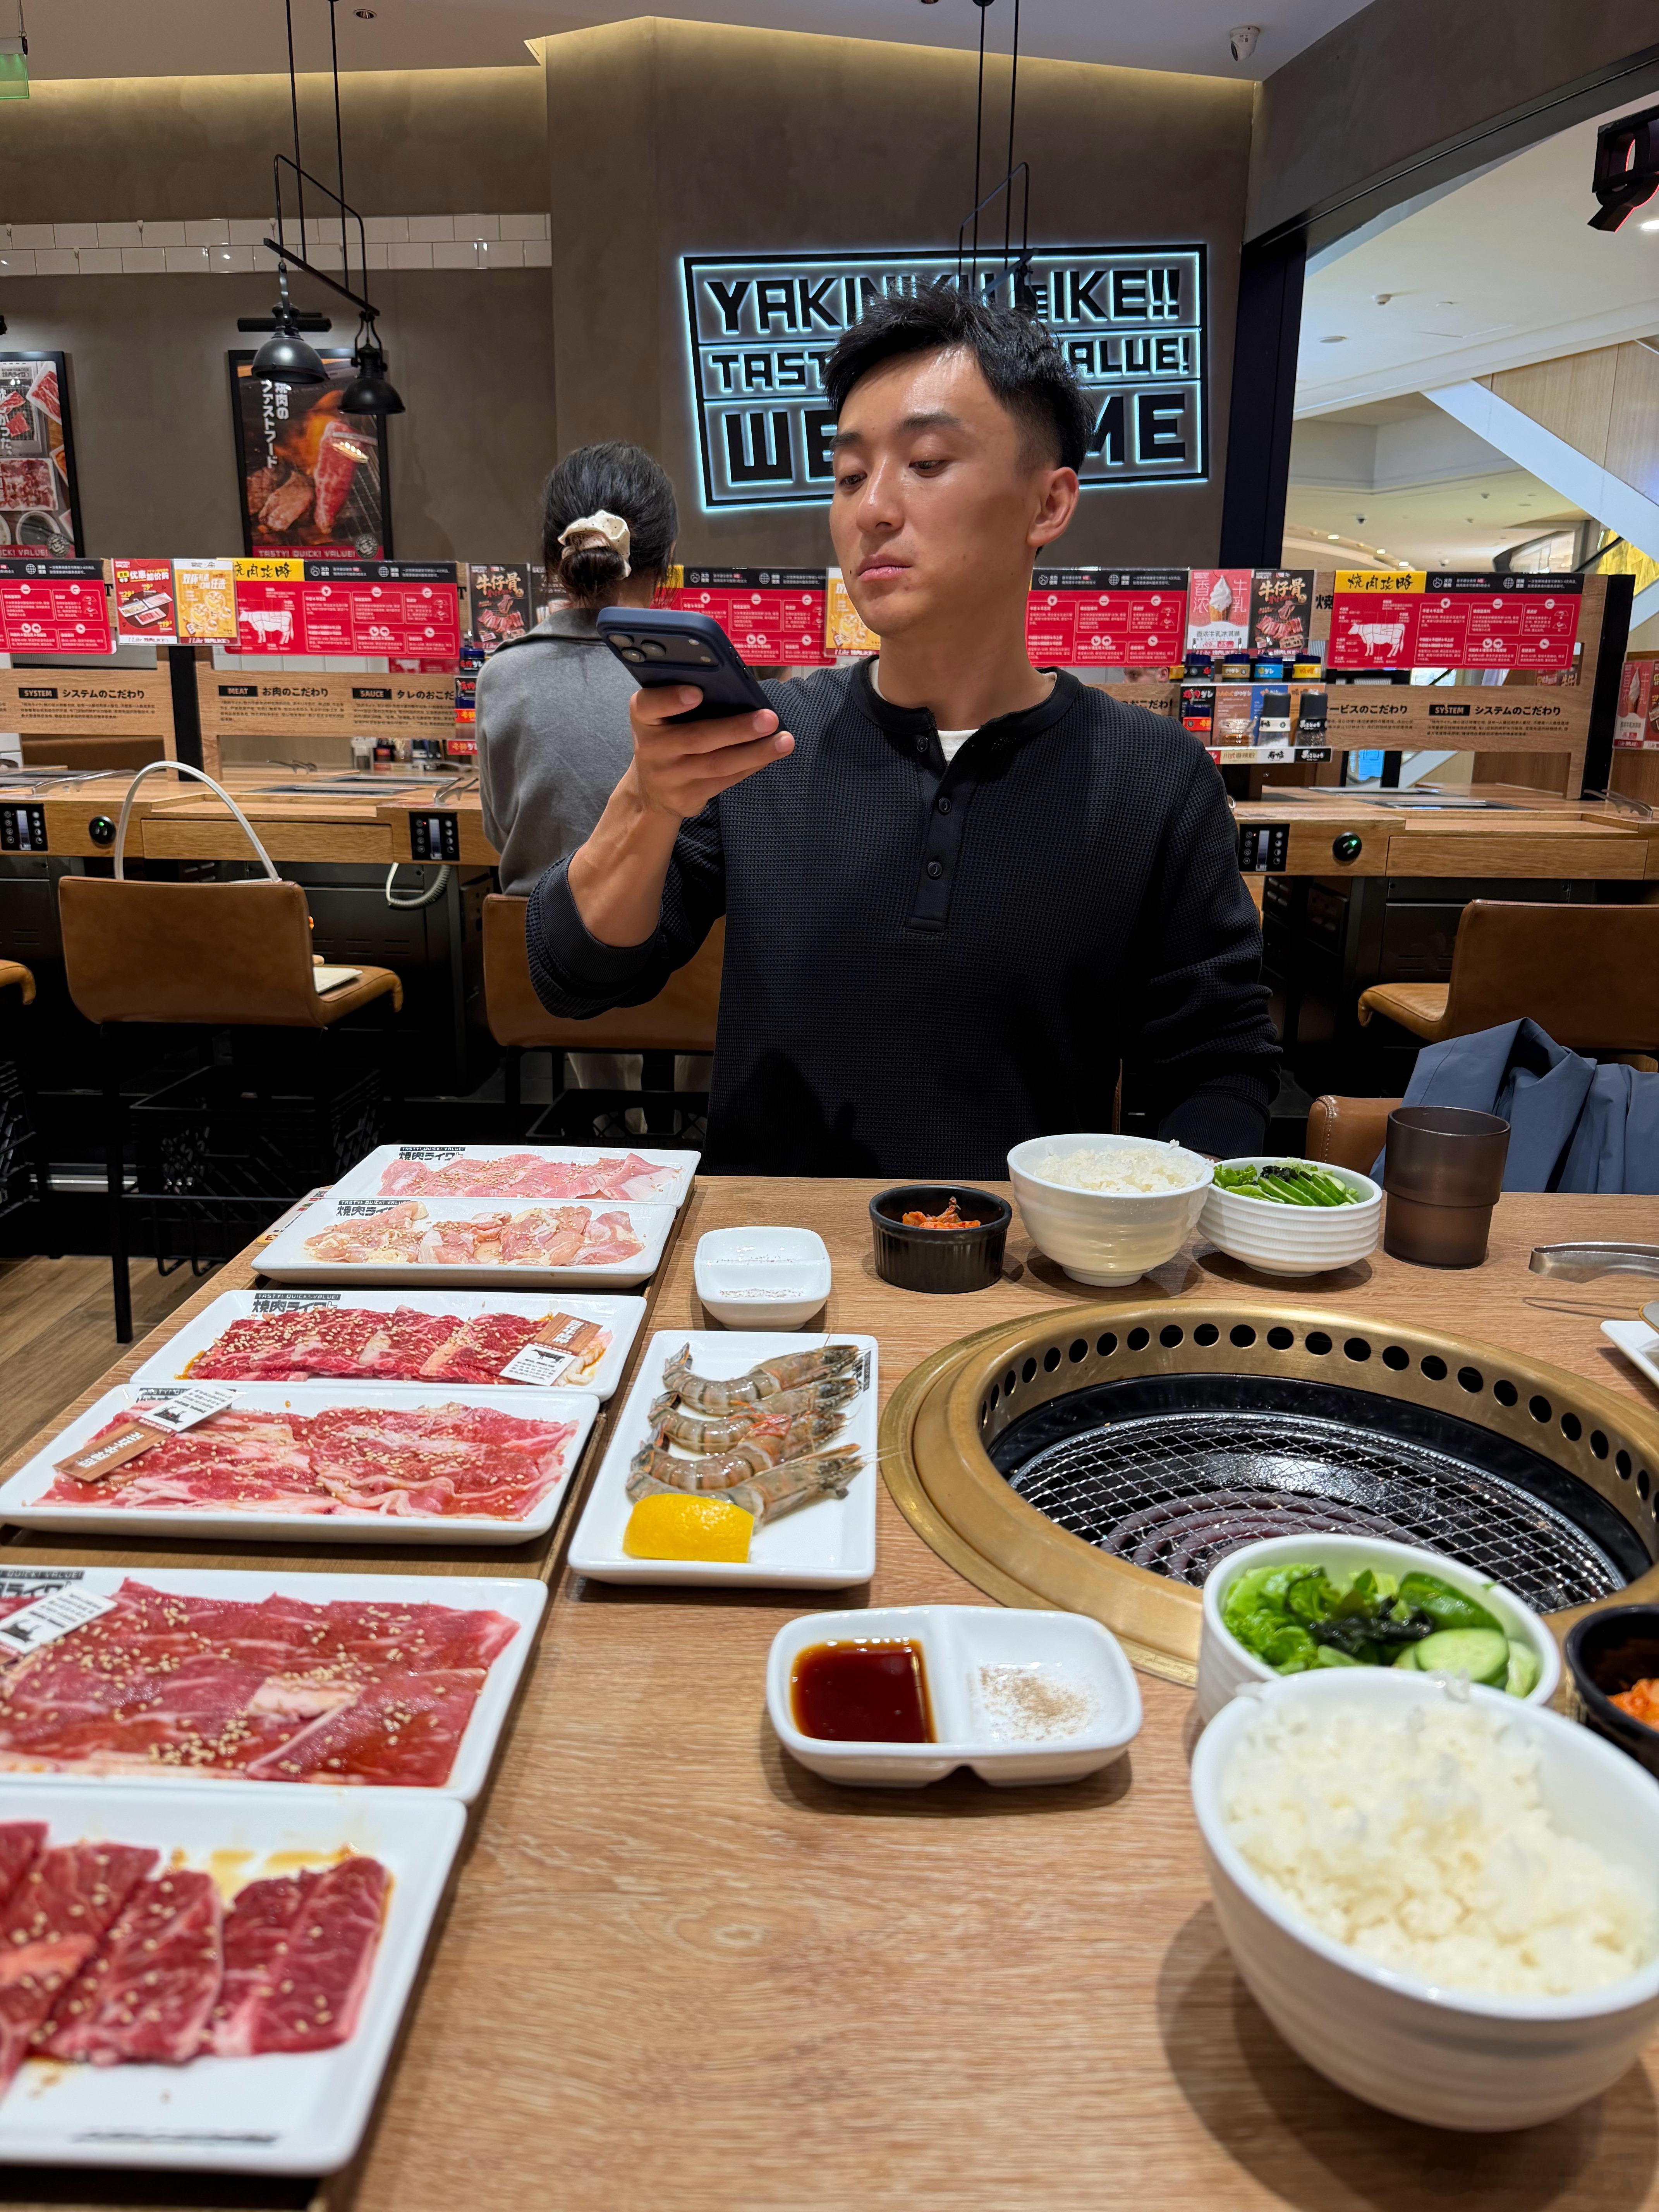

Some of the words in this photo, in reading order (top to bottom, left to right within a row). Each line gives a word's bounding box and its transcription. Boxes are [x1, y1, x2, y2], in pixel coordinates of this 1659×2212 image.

[704, 273, 995, 334] YAKI
[709, 350, 826, 393] TAST
[1063, 336, 1189, 376] ALUE!
[1258, 577, 1306, 602] 牛仔骨
[62, 689, 145, 699] システムのこだわり
[262, 687, 328, 697] お肉のこだわり
[1327, 704, 1407, 714] ービスのこだわり
[1475, 706, 1561, 716] システムのこだわり
[336, 1206, 395, 1216] 焼肉ライ
